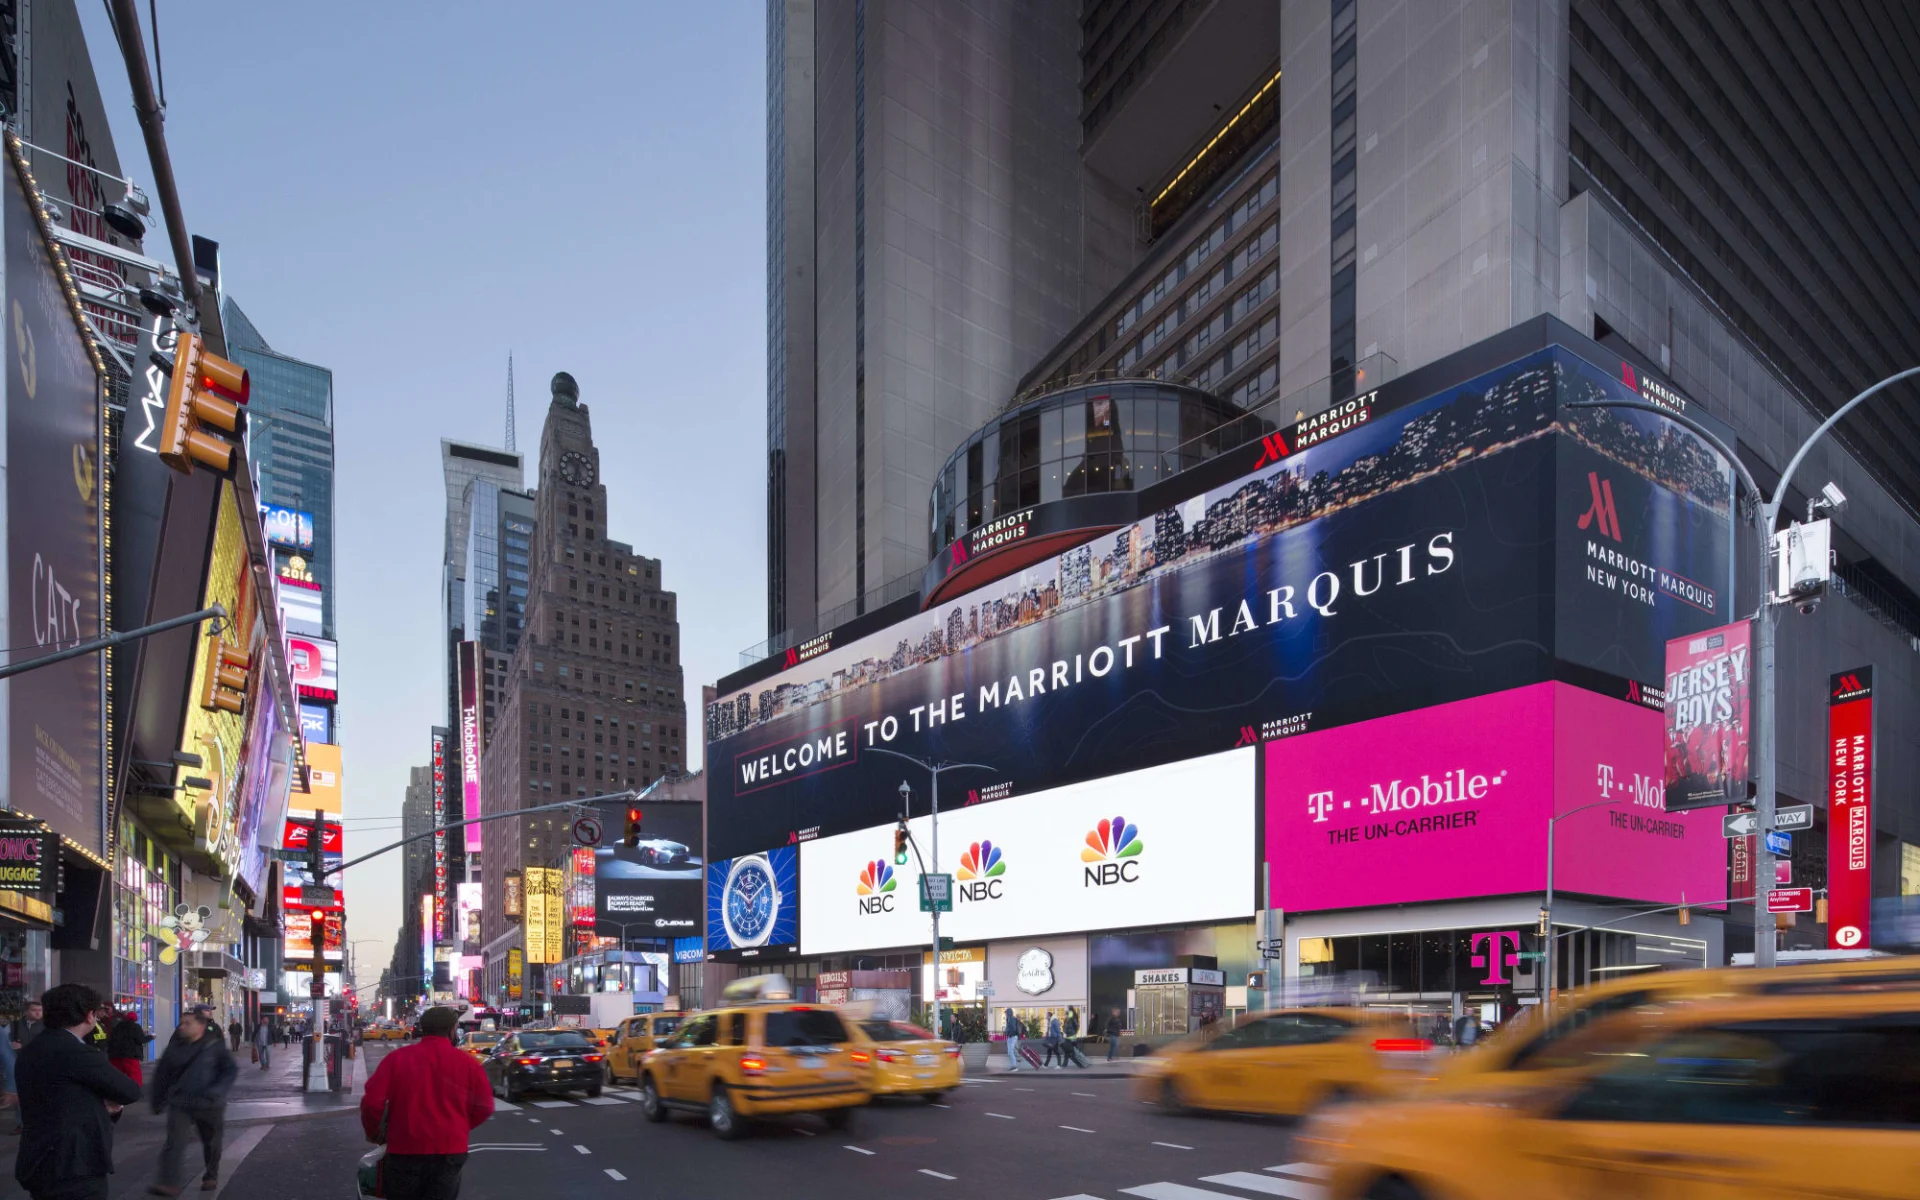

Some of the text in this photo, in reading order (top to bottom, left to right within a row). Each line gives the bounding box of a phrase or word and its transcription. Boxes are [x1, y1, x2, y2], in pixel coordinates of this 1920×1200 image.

[1642, 376, 1686, 411] MARRIOTT
[1297, 390, 1378, 434] MARRIOTT
[1297, 410, 1368, 449] MARQUIS
[972, 510, 1034, 540] MARRIOTT
[973, 526, 1026, 554] MARQUIS
[281, 566, 313, 582] 2016
[1587, 540, 1714, 609] MARRIOTT MARQUIS
[1587, 564, 1656, 607] NEW YORK
[32, 552, 80, 653] CATS
[800, 631, 833, 651] MARRIOTT
[800, 642, 829, 660] MARQUIS
[742, 531, 1455, 784] WELCOME TO THE MARRIOTT MARQUIS
[1666, 649, 1747, 703] JERSEY
[1642, 685, 1666, 699] MARRIO
[1838, 688, 1871, 699] MARRIOTT
[1262, 712, 1313, 730] MARRIOTT
[1676, 686, 1733, 731] BOYS
[1262, 723, 1307, 739] MARQUIS
[1834, 738, 1847, 806] NEW YORK
[982, 781, 1013, 793] MARRIOTT
[982, 789, 1009, 802] MARQUIS
[1852, 735, 1865, 868] MARRIOTT MARQUIS
[1327, 810, 1480, 845] THE UN-CARRIER
[1609, 810, 1685, 840] THE UN-CARRIER
[1777, 813, 1801, 825] WAY
[1084, 859, 1140, 888] NBC
[859, 894, 894, 916] NBC
[960, 879, 1003, 903] NBC
[1844, 930, 1855, 943] P
[819, 972, 847, 985] VIRGIL'S
[1142, 973, 1180, 983] SHAKES
